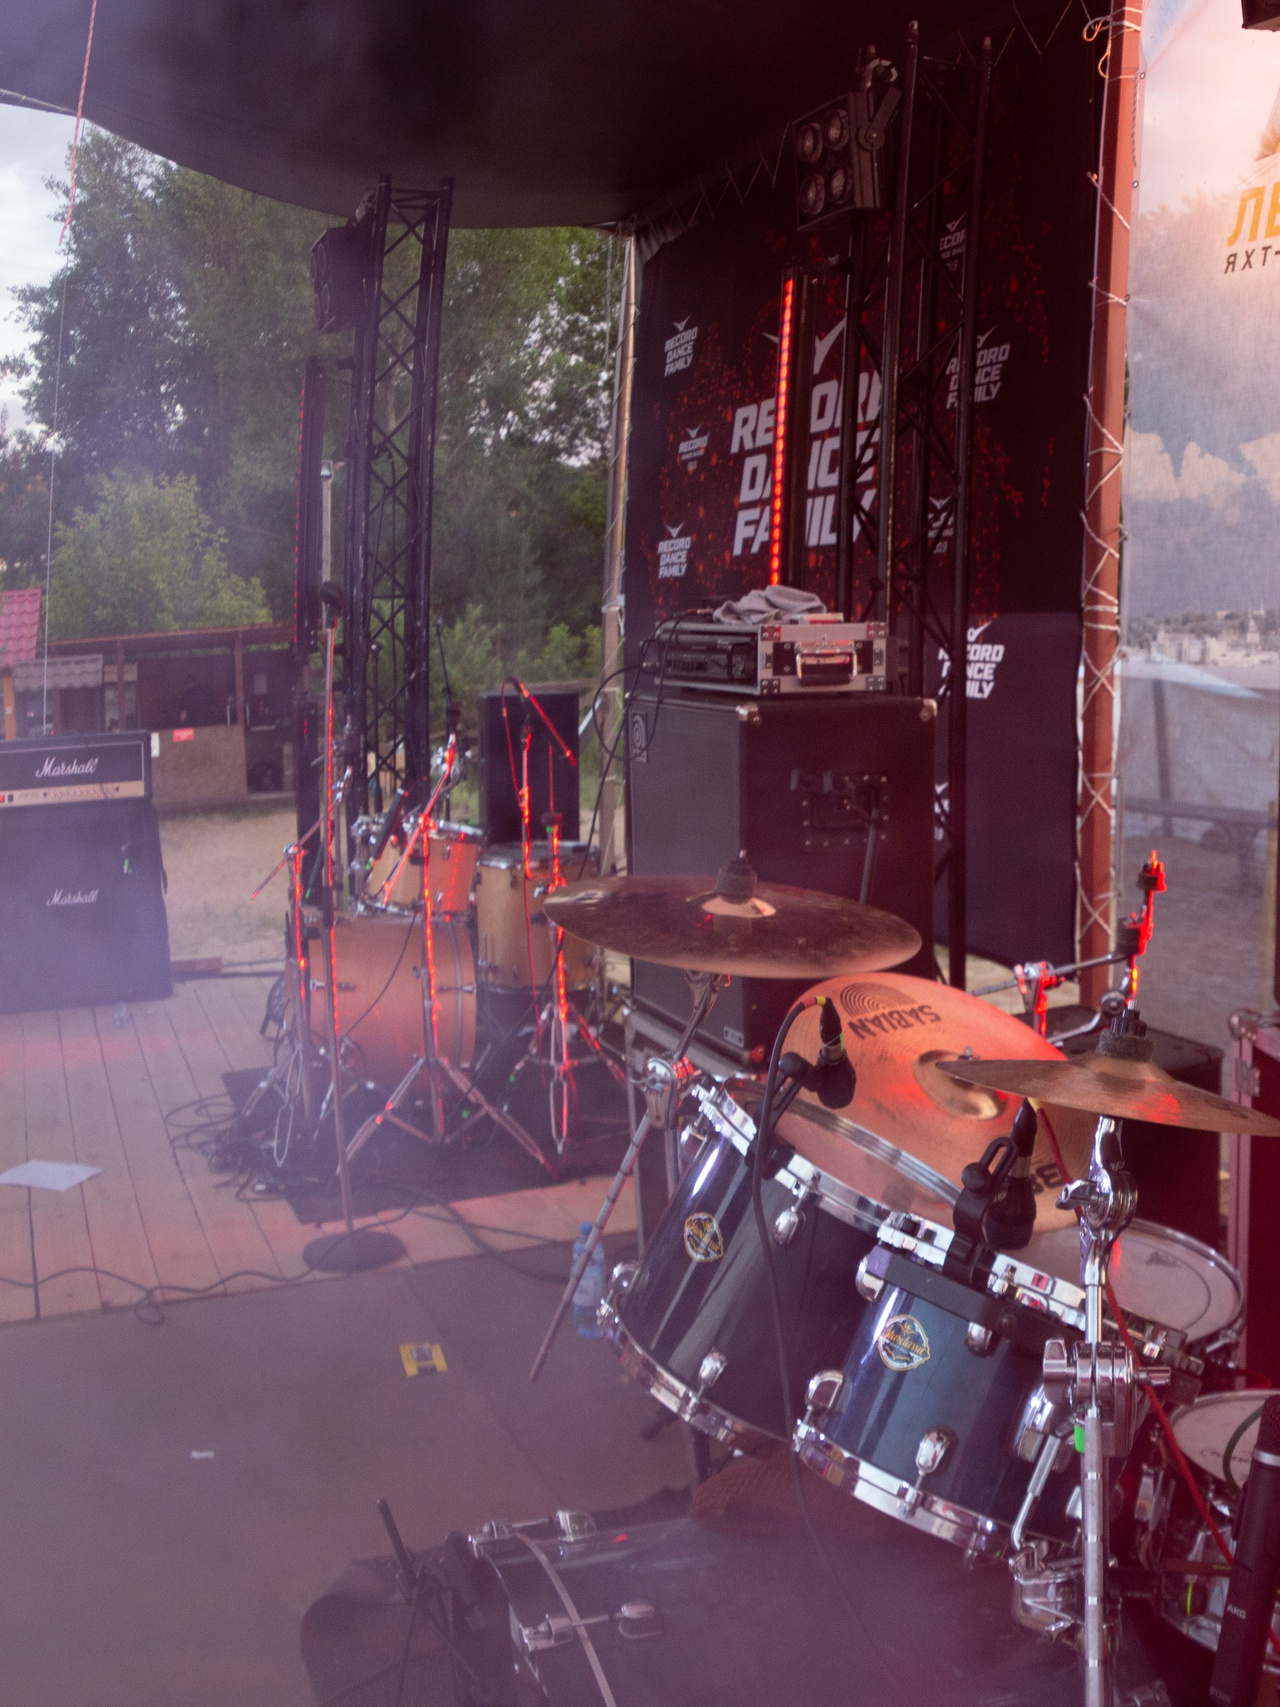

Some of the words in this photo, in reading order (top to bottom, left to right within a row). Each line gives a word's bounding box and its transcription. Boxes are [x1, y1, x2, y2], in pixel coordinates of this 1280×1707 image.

[664, 326, 699, 353] RECORD
[666, 341, 695, 364] DANCE
[664, 354, 693, 377] FAMILY
[657, 536, 692, 555] RECORD
[660, 550, 688, 567] DANCE
[658, 562, 688, 580] FAMILY
[35, 757, 99, 778] Marshall
[46, 889, 99, 907] Marshall
[848, 1005, 942, 1041] SABIAN
[1226, 1604, 1247, 1621] AKG
